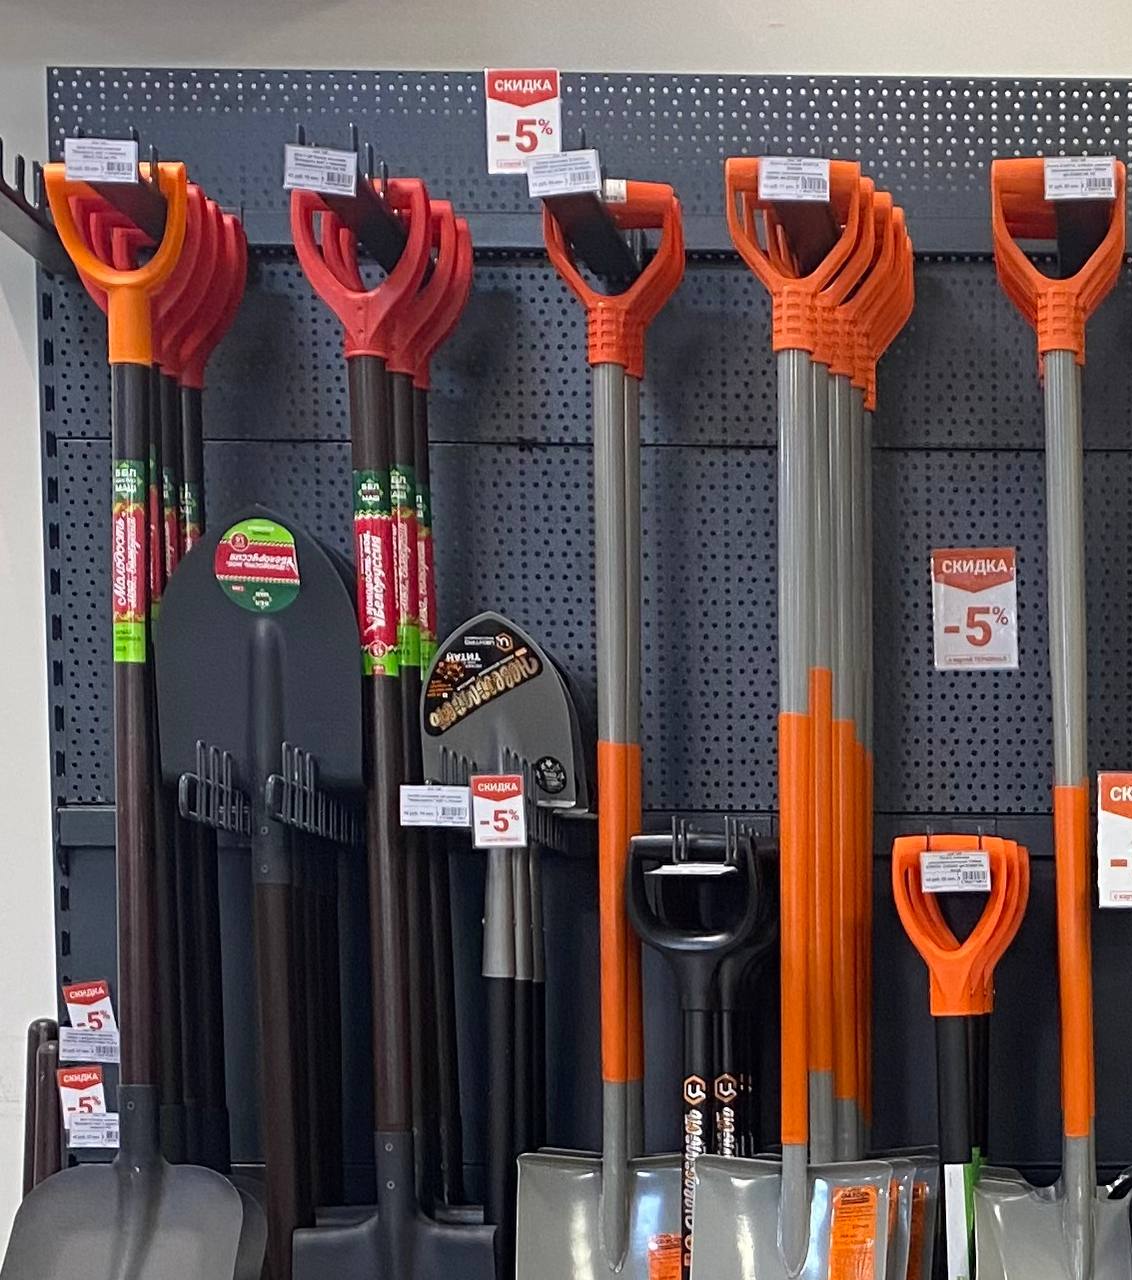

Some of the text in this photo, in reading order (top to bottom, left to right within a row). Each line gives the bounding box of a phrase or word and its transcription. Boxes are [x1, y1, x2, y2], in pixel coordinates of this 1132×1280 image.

[494, 77, 553, 95] СКИДКА
[496, 118, 553, 154] -5%
[942, 557, 1008, 578] СКИДКА
[944, 606, 1009, 648] -5%
[477, 780, 519, 795] СКИДКА
[480, 809, 520, 833] -5%
[69, 987, 107, 1001] СКИДКА
[64, 1074, 100, 1086] СКИДКА
